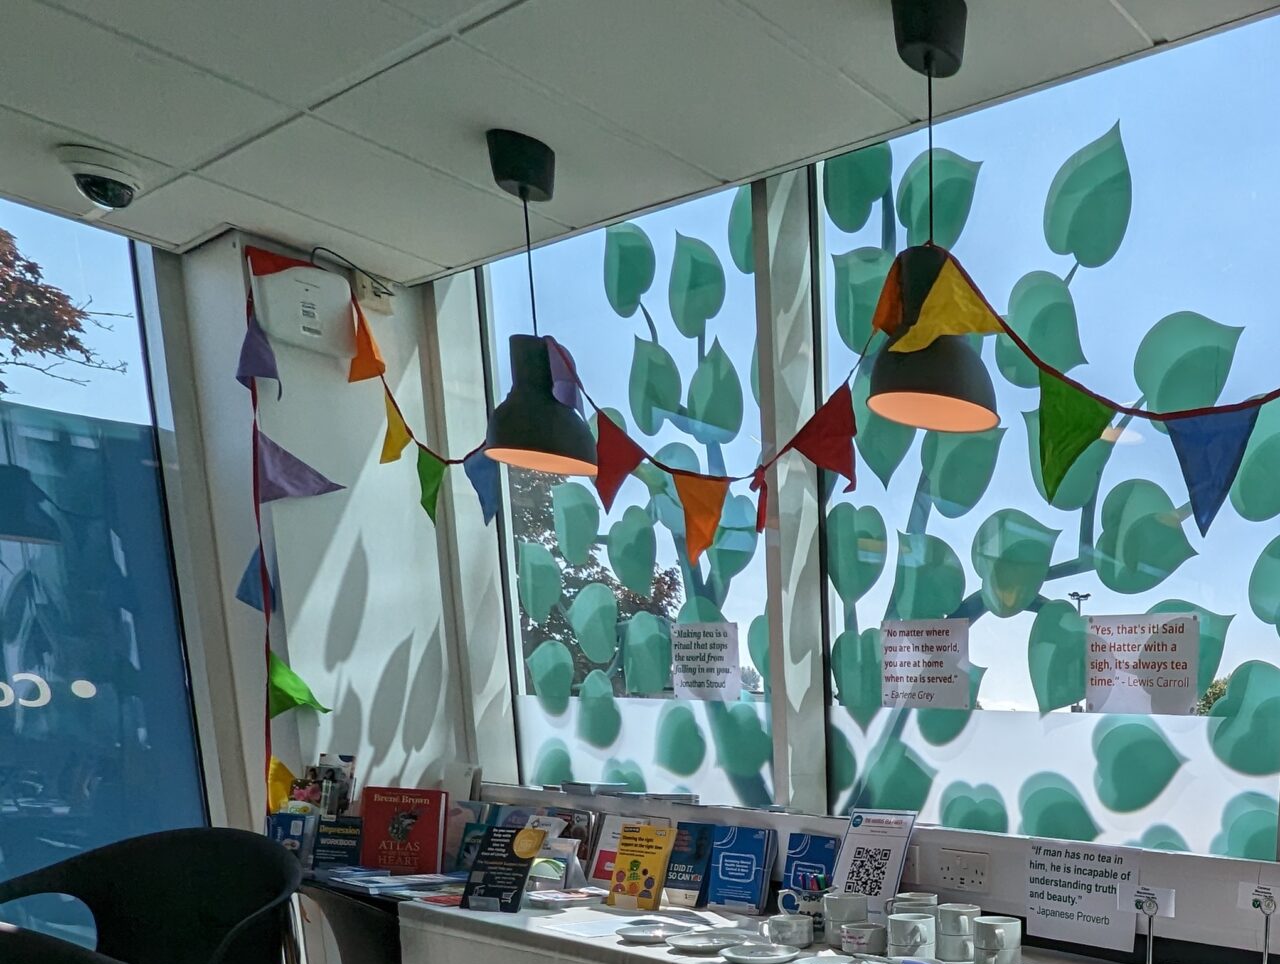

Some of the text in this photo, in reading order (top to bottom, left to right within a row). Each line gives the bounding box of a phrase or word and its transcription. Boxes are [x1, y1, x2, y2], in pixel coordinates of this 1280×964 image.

[702, 630, 714, 638] tea
[714, 628, 722, 638] is
[925, 628, 950, 637] where
[1148, 624, 1159, 634] it!
[1162, 623, 1185, 634] Said
[674, 642, 728, 652] ritual that stops
[884, 643, 960, 655] you are in the world,
[1090, 641, 1177, 652] the Hatter with a
[674, 652, 724, 664] the world from
[673, 664, 697, 676] falling
[698, 665, 705, 674] in
[884, 659, 944, 670] you are at home
[1090, 659, 1112, 672] sigh,
[1132, 658, 1168, 672] always
[1170, 661, 1188, 670] tea
[680, 680, 706, 688] Jonathan
[706, 680, 726, 688] Stroud
[884, 674, 905, 683] when
[906, 675, 918, 683] tea
[919, 674, 926, 683] is
[1127, 676, 1154, 687] Lewis
[1156, 676, 1190, 688] Carroll
[890, 690, 916, 699] Earlene
[917, 690, 935, 702] Grey
[402, 796, 430, 805] Brown
[378, 840, 420, 851] ATLAS
[378, 856, 418, 866] HEART
[1043, 848, 1062, 858] man
[1064, 849, 1081, 860] has
[1083, 852, 1096, 862] no
[1097, 853, 1112, 864] tea
[1114, 854, 1123, 864] in
[668, 871, 677, 880] SO
[677, 872, 690, 881] CAN
[1029, 860, 1131, 881] him, he is incapable of
[1029, 876, 1117, 894] understanding truth
[1029, 890, 1044, 900] and
[1036, 906, 1075, 920] Japanese
[1076, 911, 1110, 926] Proverb
